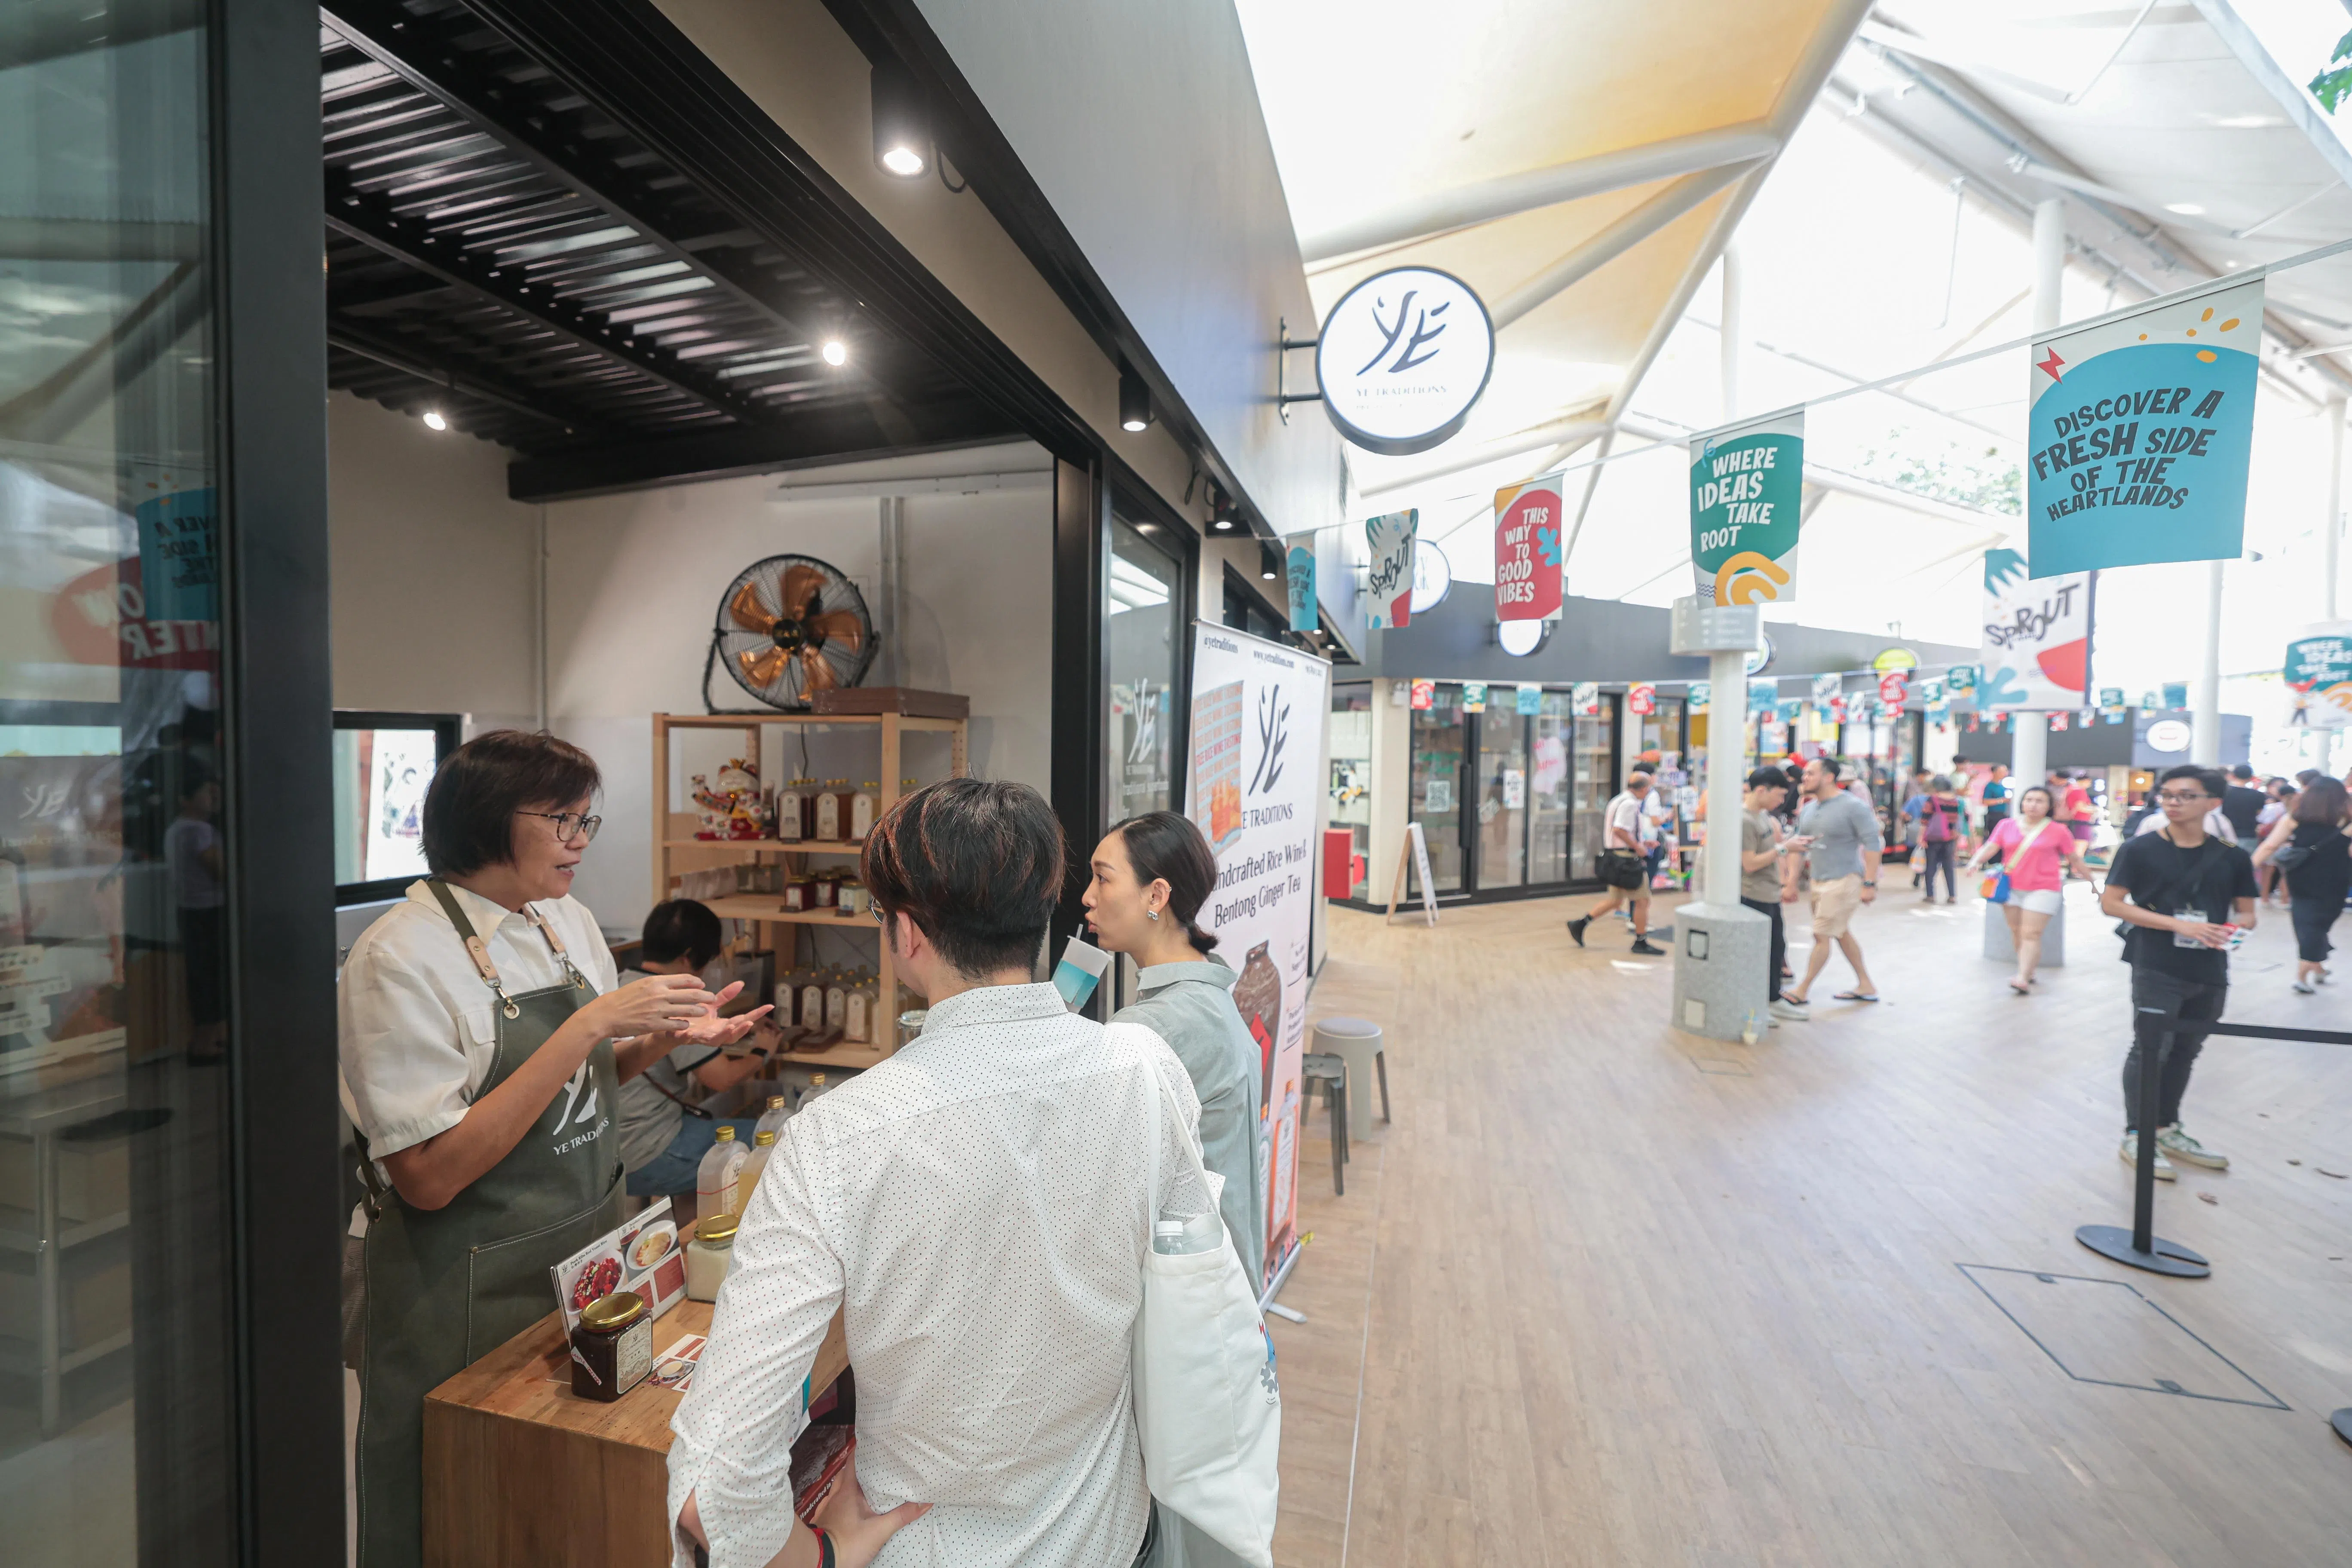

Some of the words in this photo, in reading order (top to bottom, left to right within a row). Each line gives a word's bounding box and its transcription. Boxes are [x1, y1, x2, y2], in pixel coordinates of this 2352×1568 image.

[1357, 291, 1450, 376] YE
[2054, 387, 2191, 438] DISCOVER
[2191, 389, 2225, 420] A
[1712, 447, 1778, 479] WHERE
[2031, 421, 2139, 482] FRESH
[2144, 427, 2217, 457] SIDE
[1697, 471, 1764, 512] IDEAS
[2070, 465, 2102, 493] OF
[2115, 457, 2176, 485] THE
[1522, 507, 1549, 525] THIS
[1725, 502, 1774, 525] TAKE
[2046, 486, 2189, 522] HEARTLANDS
[1504, 524, 1532, 546] WAY
[1515, 542, 1530, 560] TO
[1700, 525, 1742, 553] ROOT
[1370, 533, 1412, 600] SPROUT
[1498, 558, 1533, 584] GOOD
[1496, 581, 1536, 606] VIBES
[1985, 583, 2082, 650] SPROUT
[1248, 683, 1290, 796] YE
[1250, 802, 1294, 829] TRADITIONS
[1213, 853, 1265, 891] ndcrafted
[1267, 849, 1283, 872] Rice
[1215, 894, 1257, 929] Bentong
[1259, 882, 1286, 907] Ginger
[1287, 873, 1302, 895] Tea
[553, 1142, 570, 1155] YE
[799, 1485, 827, 1520] Handcrafted
